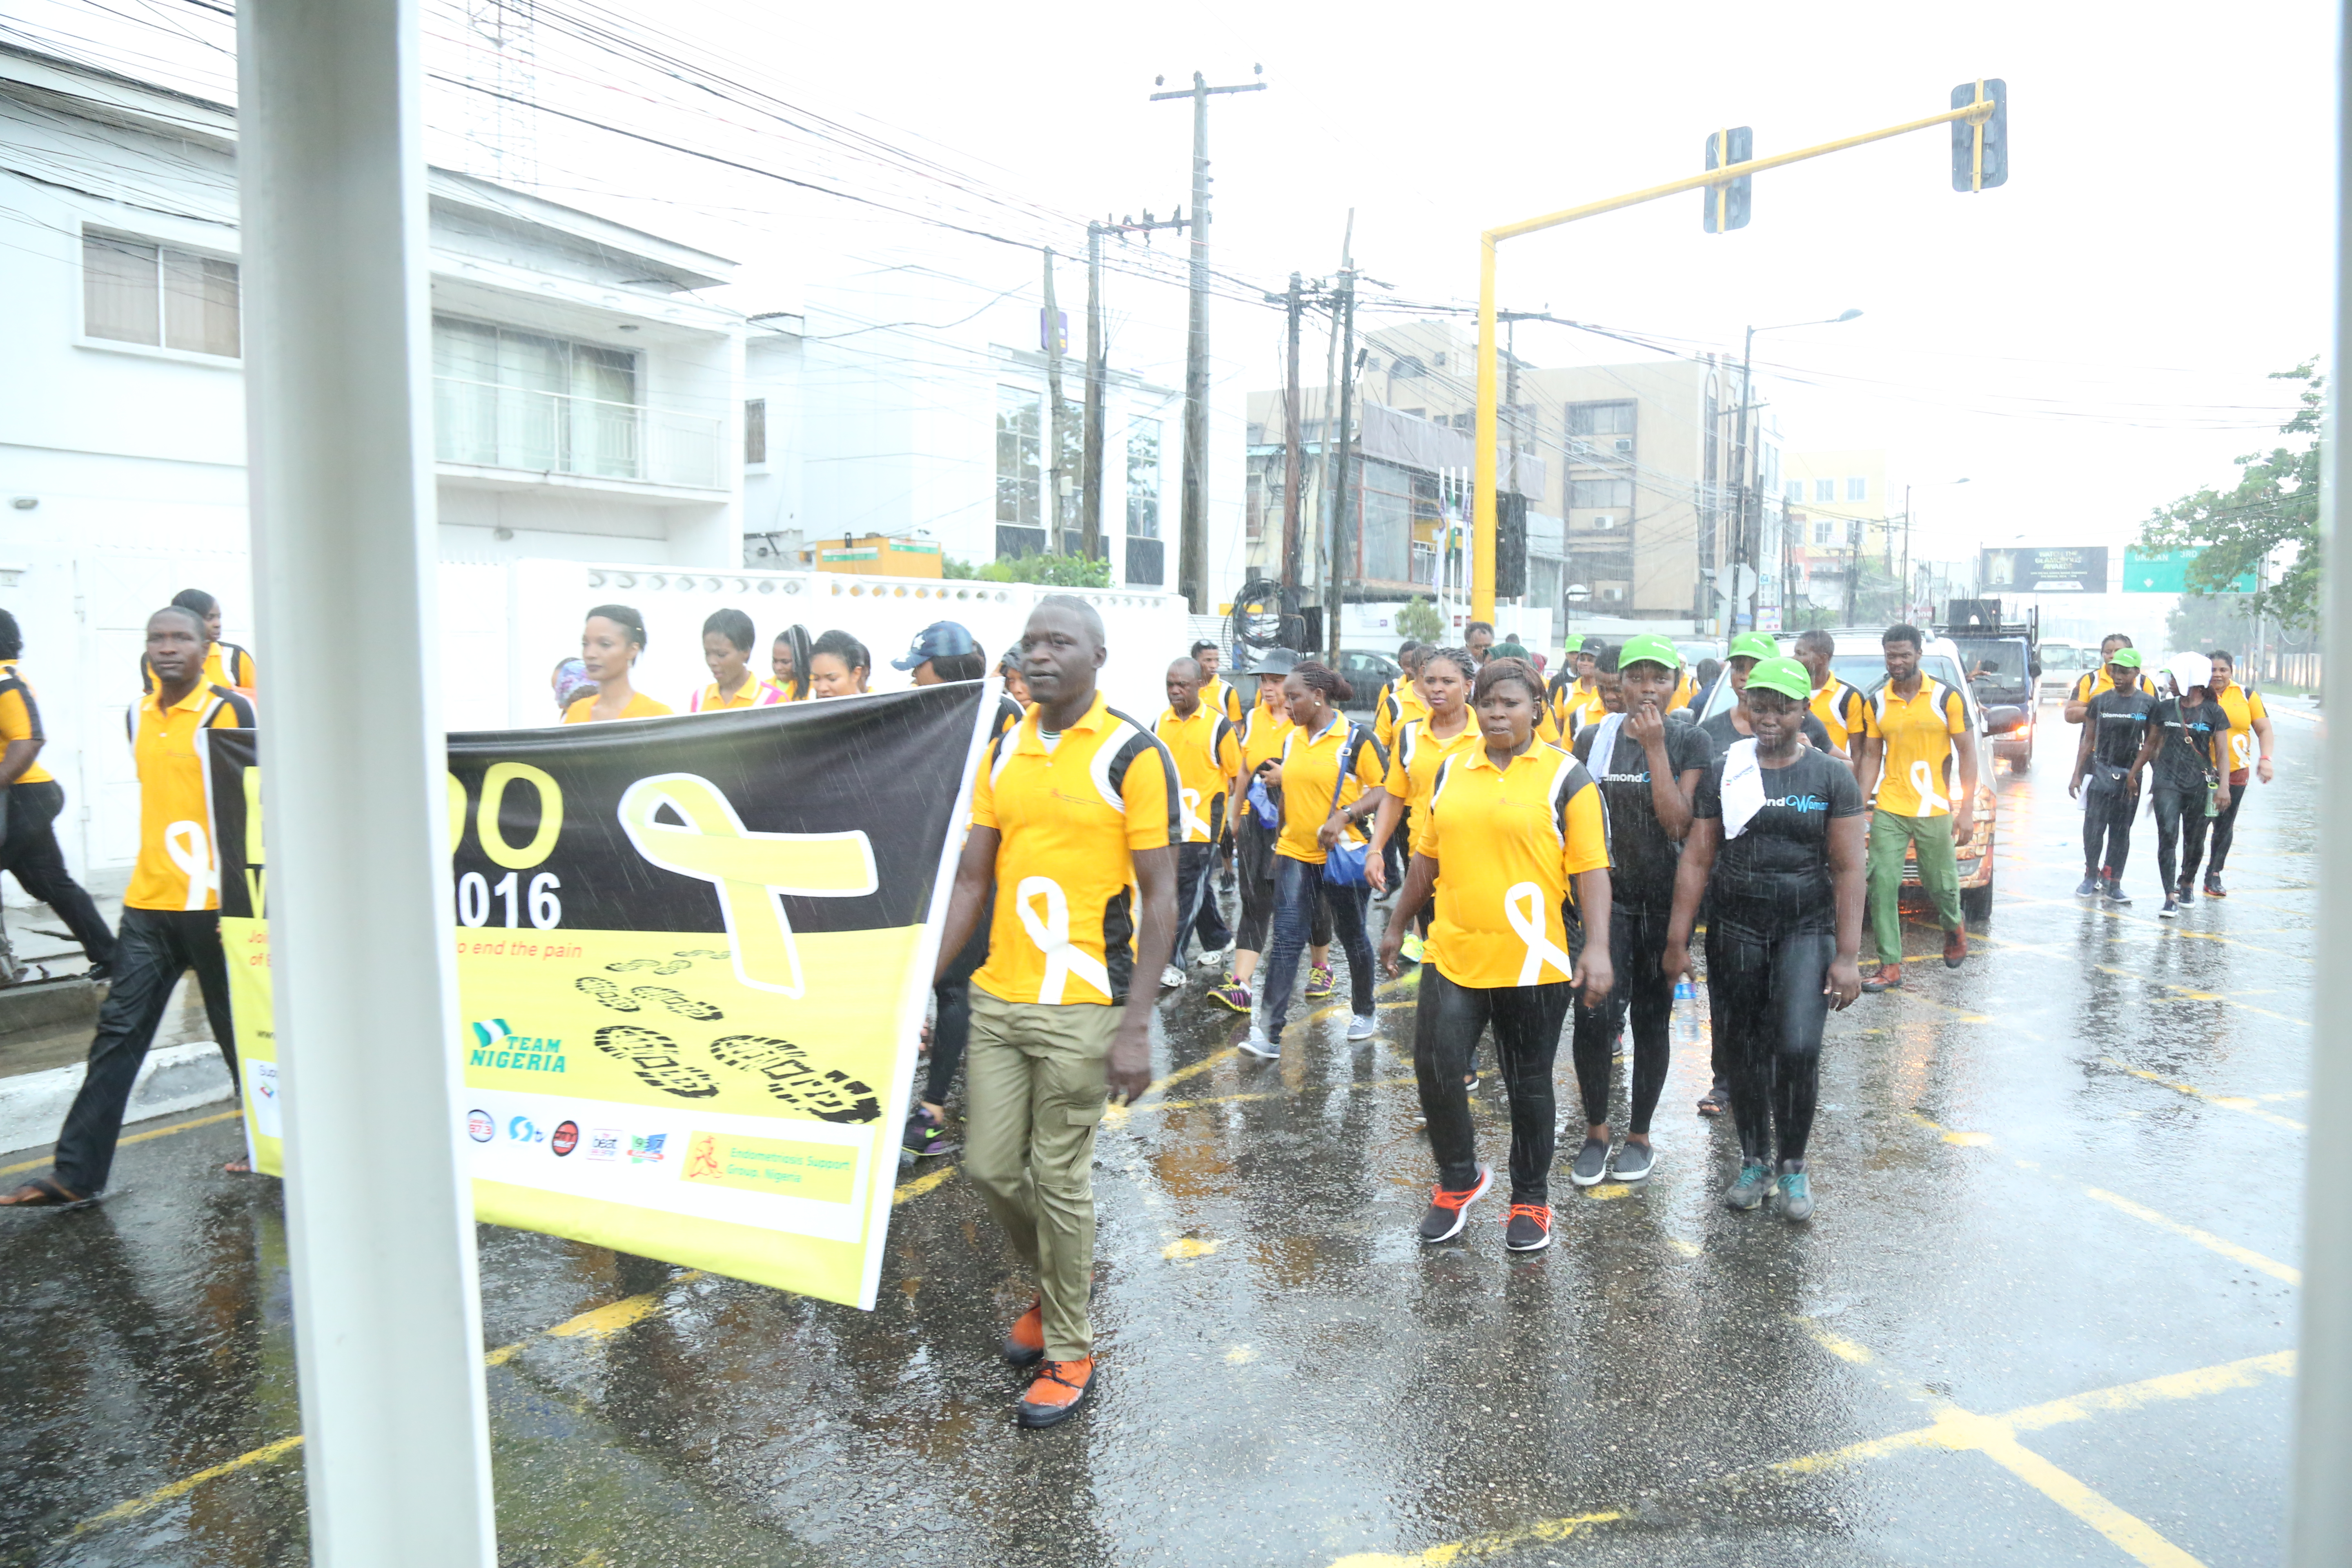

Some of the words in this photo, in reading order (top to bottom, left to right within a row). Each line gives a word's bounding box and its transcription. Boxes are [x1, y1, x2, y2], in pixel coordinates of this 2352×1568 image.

[459, 871, 561, 931] 016
[472, 940, 506, 955] end
[510, 941, 538, 956] the
[542, 942, 582, 961] pain
[506, 1036, 561, 1053] TEAM
[470, 1049, 566, 1073] NIGERIA
[592, 1135, 618, 1149] beat
[730, 1147, 804, 1165] Endometriosis
[806, 1155, 851, 1171] Support
[764, 1168, 802, 1183] Nigeria
